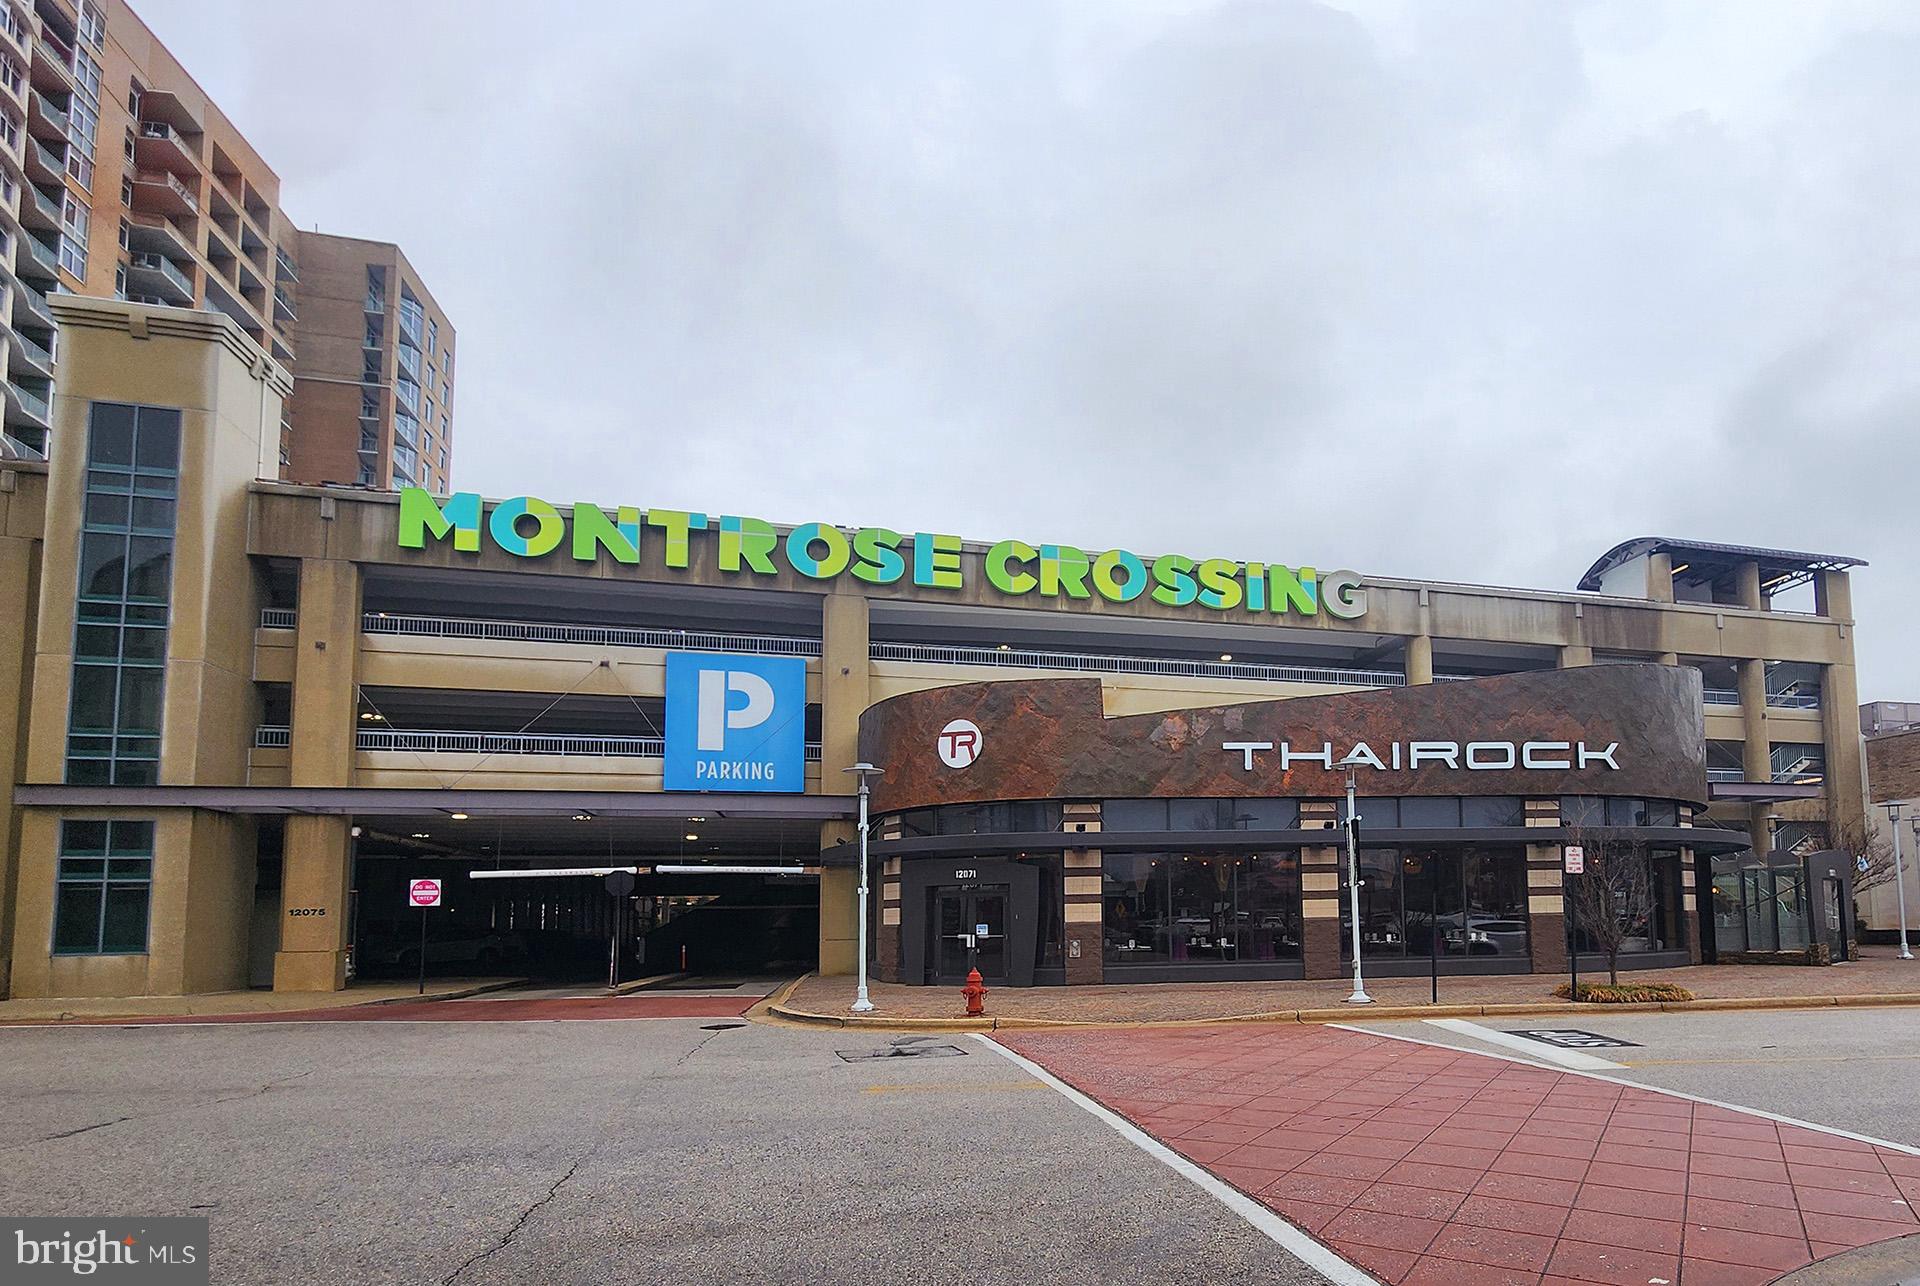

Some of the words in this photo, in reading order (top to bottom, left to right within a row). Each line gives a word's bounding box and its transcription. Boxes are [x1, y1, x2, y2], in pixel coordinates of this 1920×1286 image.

[398, 487, 963, 589] MONTROSE
[985, 539, 1369, 619] CROSSING
[697, 669, 775, 751] P
[1222, 741, 1620, 771] THAIROCK
[696, 760, 775, 780] PARKING
[955, 869, 977, 879] 12071
[289, 908, 326, 917] 12075
